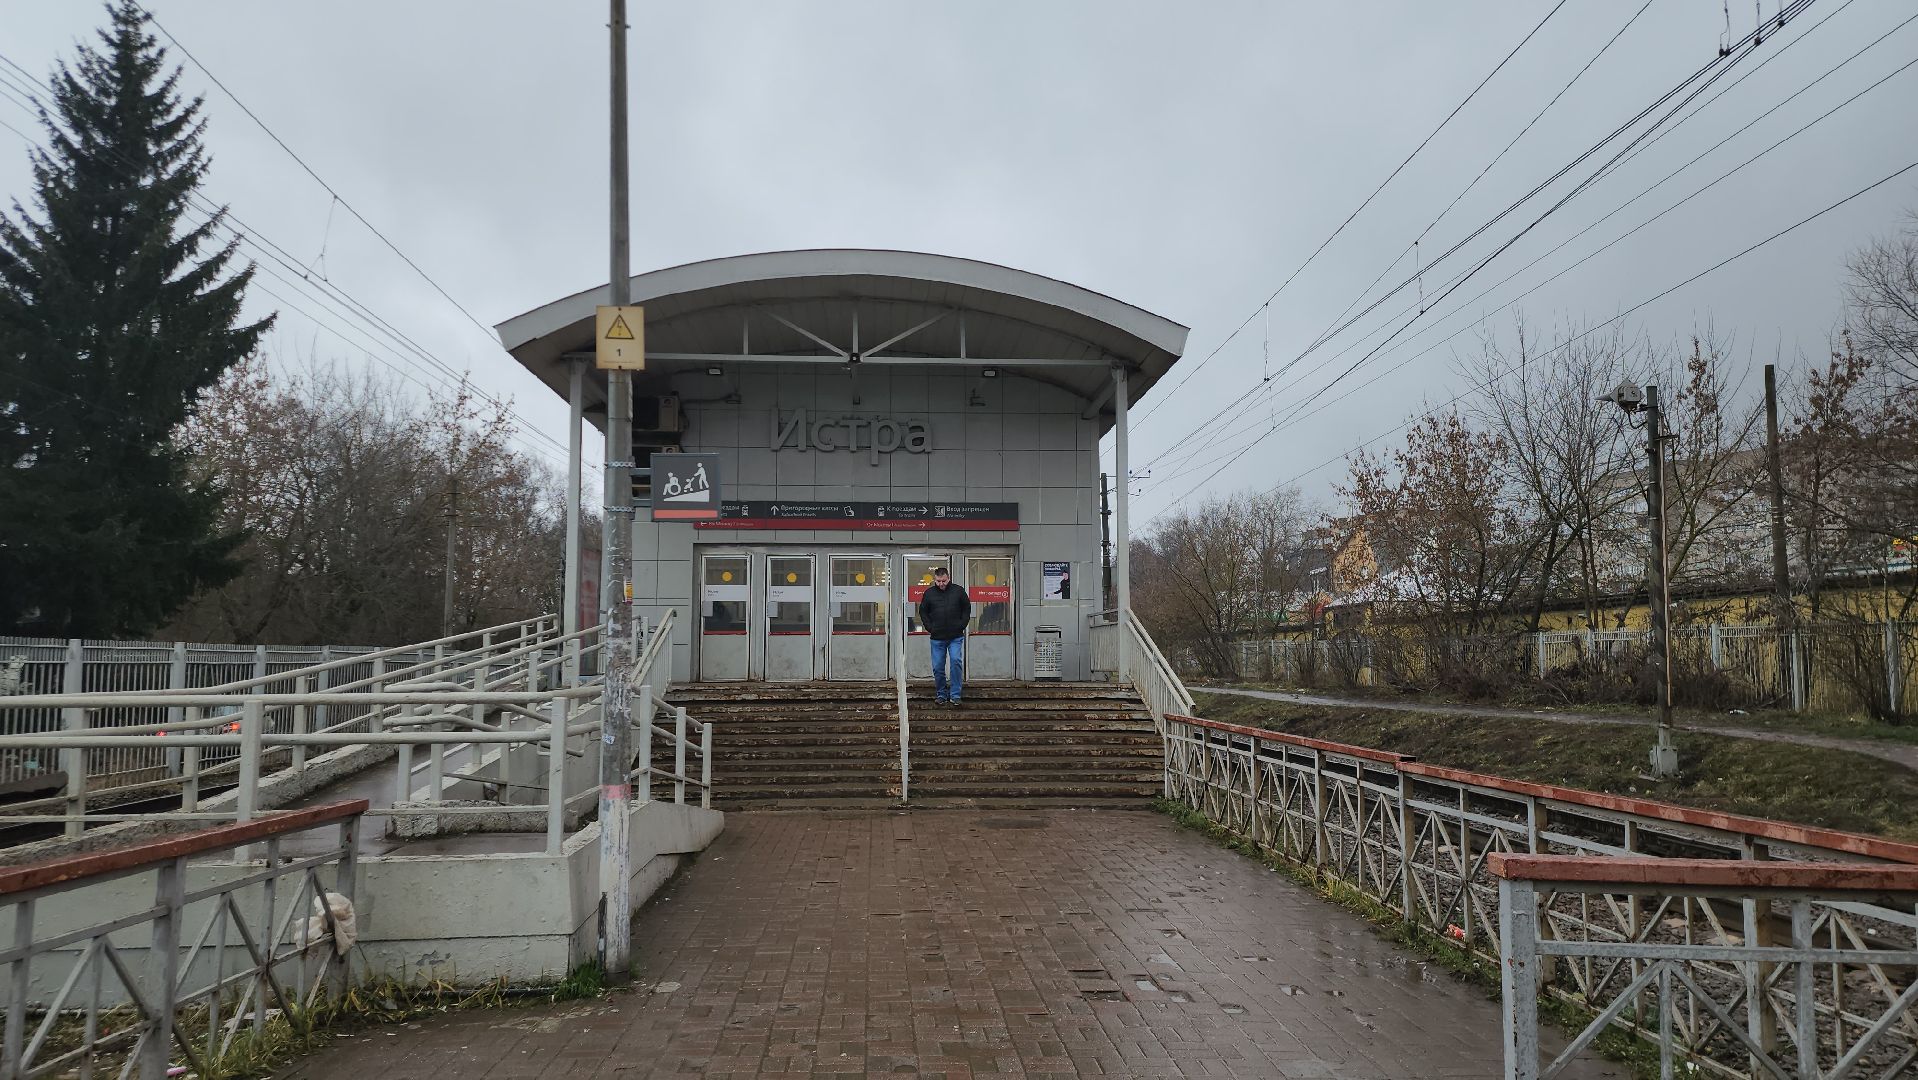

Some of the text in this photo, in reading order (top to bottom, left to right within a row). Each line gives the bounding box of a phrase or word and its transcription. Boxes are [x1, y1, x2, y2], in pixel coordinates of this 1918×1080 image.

[616, 348, 621, 357] 1
[770, 407, 933, 466] Истра
[946, 505, 961, 513] Вход
